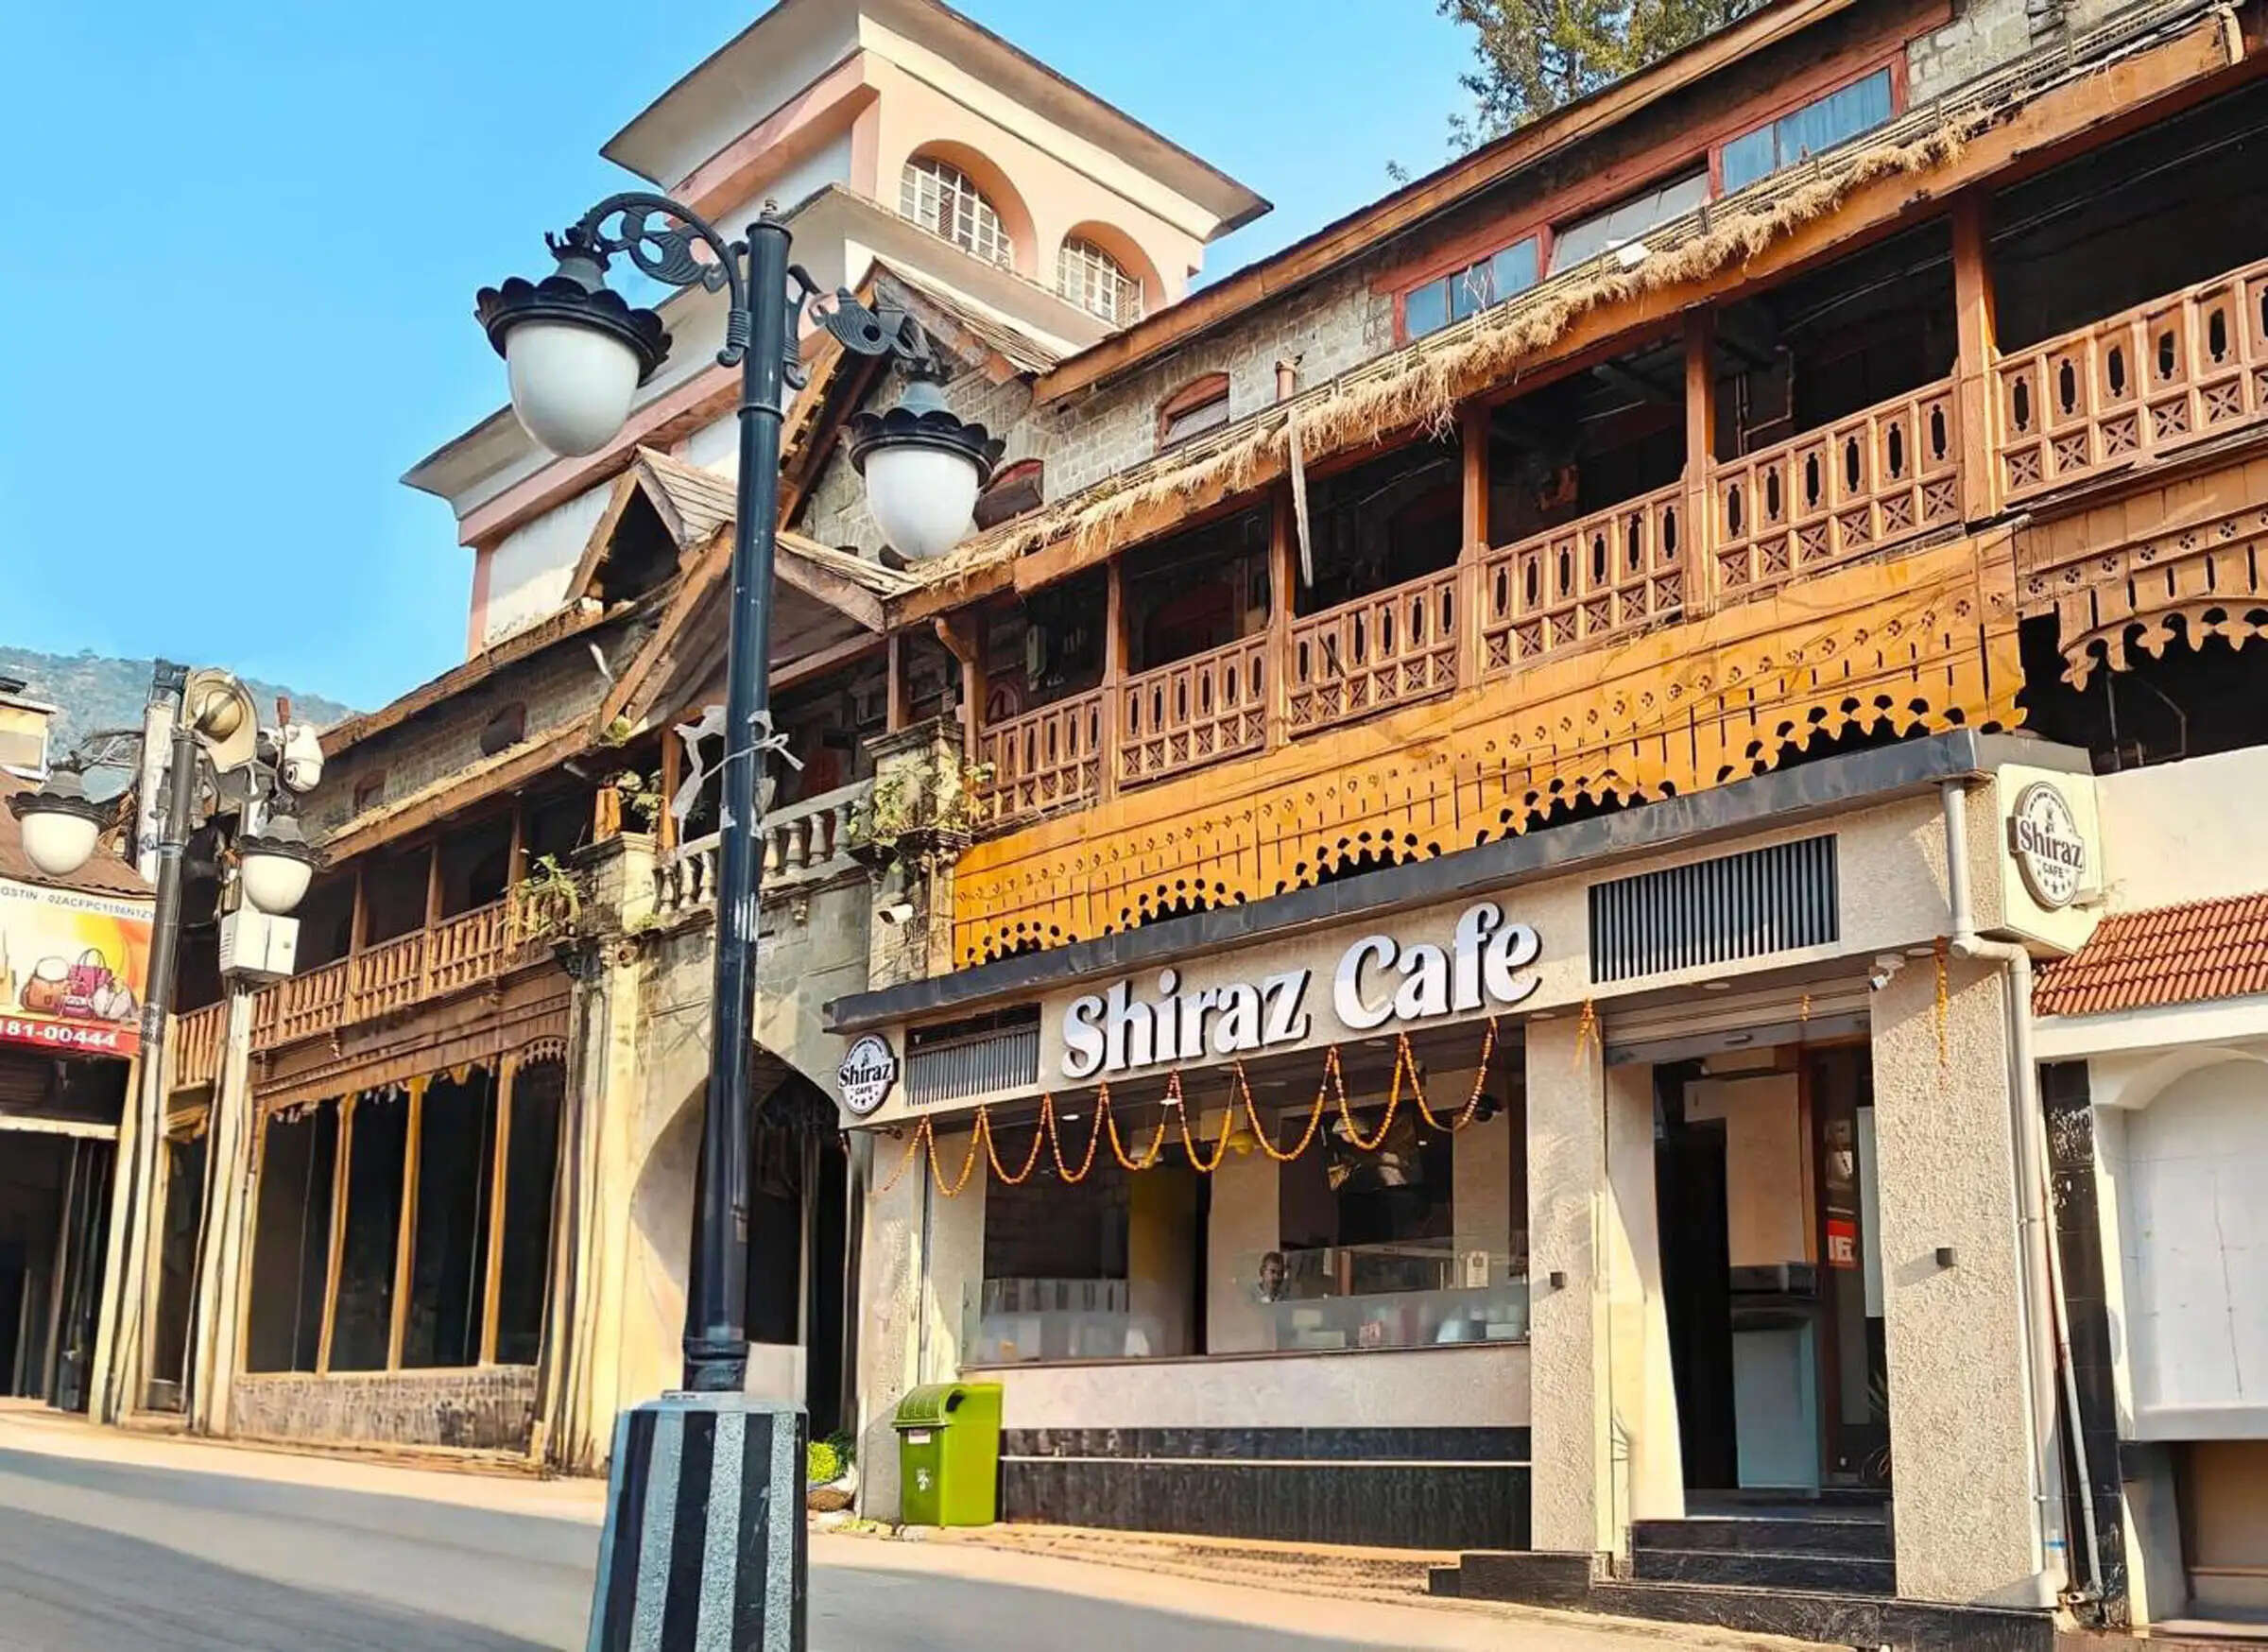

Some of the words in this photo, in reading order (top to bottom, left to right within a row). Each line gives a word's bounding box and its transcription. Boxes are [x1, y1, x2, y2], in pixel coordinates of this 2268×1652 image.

[2019, 818, 2083, 869] Shiraz
[2042, 862, 2064, 878] CAFE
[1060, 969, 1312, 1079] Shiraz
[1332, 901, 1541, 1030] Cafe
[0, 1021, 115, 1045] 81-00444
[839, 1063, 891, 1087] Shiraz
